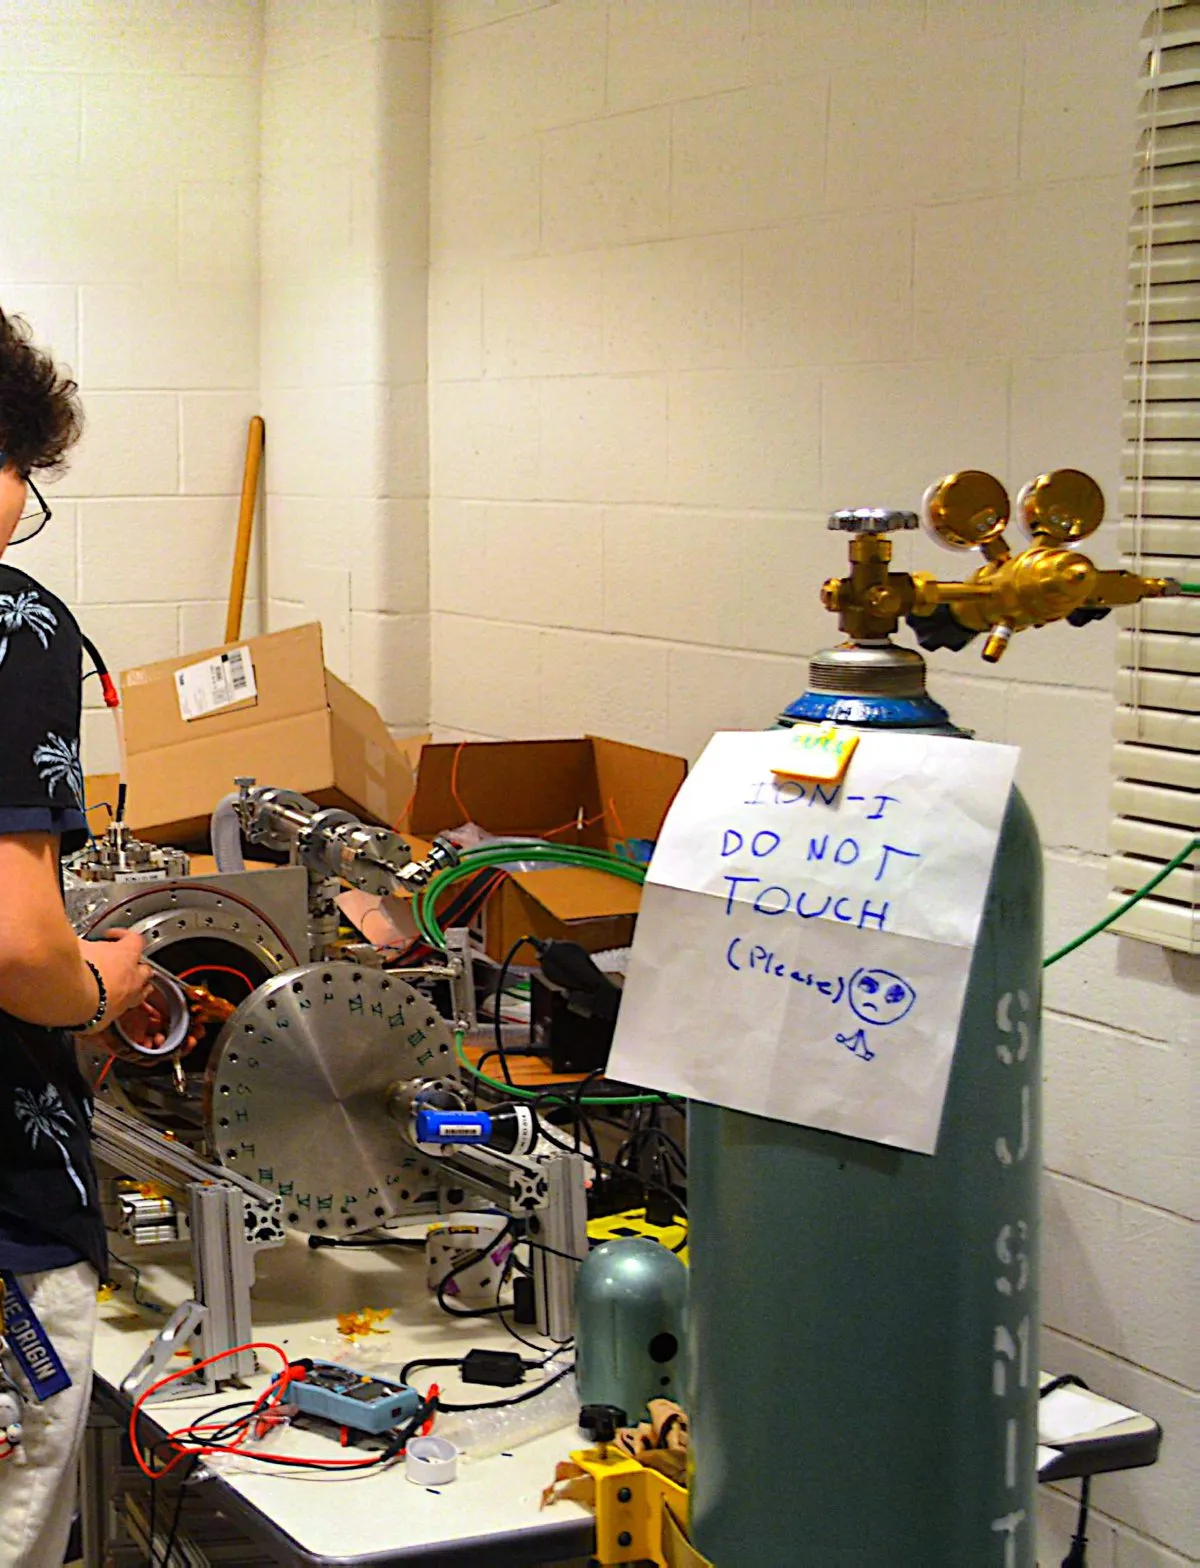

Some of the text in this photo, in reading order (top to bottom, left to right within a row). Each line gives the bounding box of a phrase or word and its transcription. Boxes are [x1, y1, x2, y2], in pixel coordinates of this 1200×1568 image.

[720, 829, 921, 881] DO NOT
[723, 875, 889, 931] TOUCH
[727, 937, 845, 1003] (Please)
[9, 1318, 57, 1381] ORIGIN
